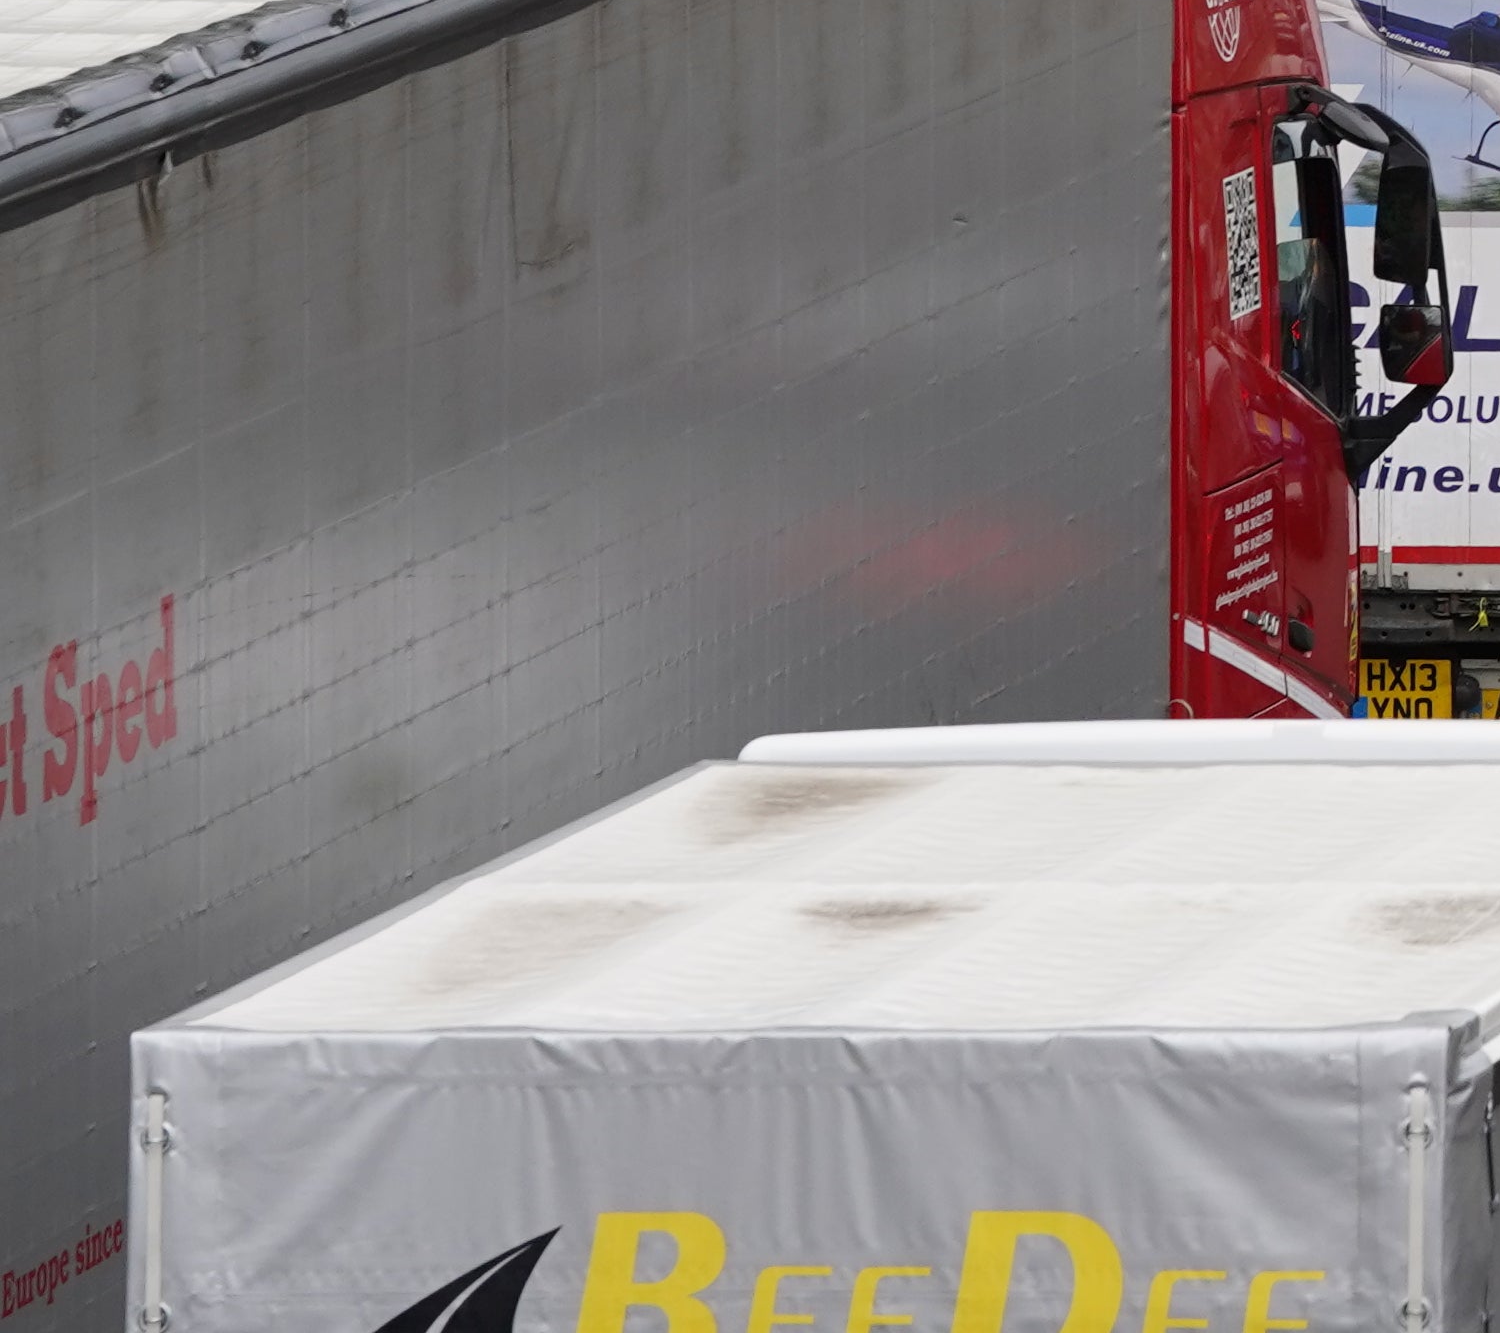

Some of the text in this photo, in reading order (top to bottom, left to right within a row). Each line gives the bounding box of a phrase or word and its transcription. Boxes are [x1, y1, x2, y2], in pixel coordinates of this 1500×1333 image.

[43, 594, 179, 827] Sped
[1365, 662, 1438, 692] HX13
[1, 1217, 124, 1321] Europe since
